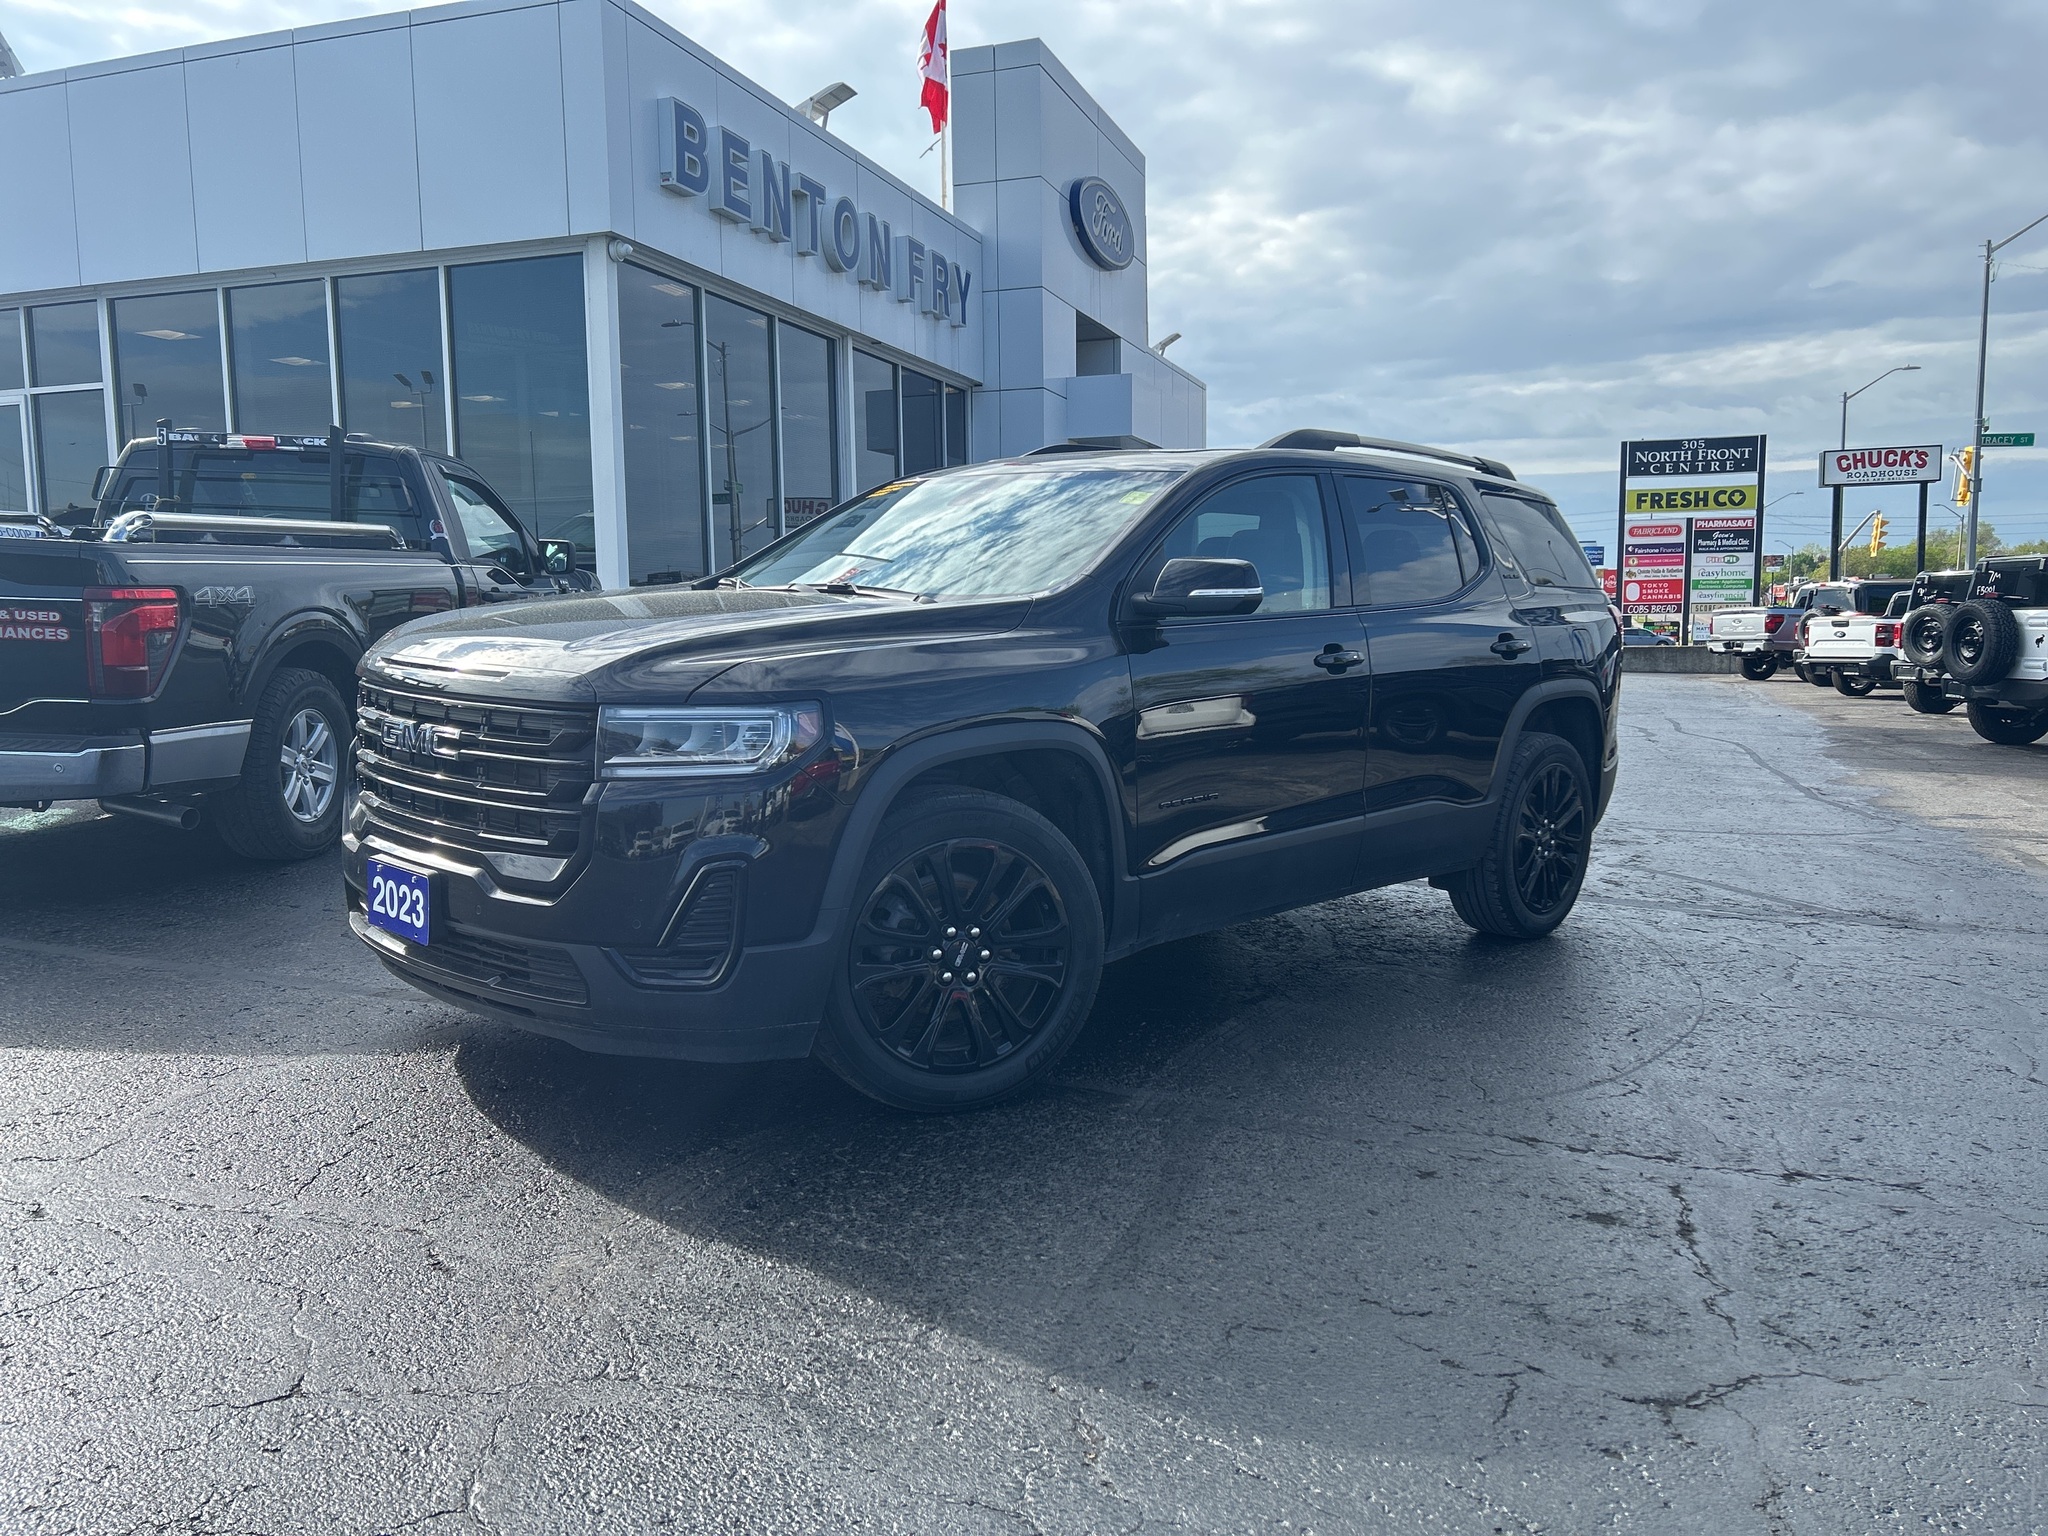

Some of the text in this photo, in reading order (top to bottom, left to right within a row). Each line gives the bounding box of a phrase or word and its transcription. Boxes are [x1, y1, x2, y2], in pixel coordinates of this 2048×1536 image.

[658, 97, 973, 328] BENTON FRY
[1092, 191, 1124, 255] Ford
[1681, 440, 1706, 450] 305
[1981, 436, 2016, 445] TRACEY
[1635, 447, 1753, 464] NORTH FRONT
[1836, 449, 1930, 473] CHUCK'S
[1649, 460, 1735, 474] CENTRE
[1846, 469, 1918, 479] ROADHOUSE
[1636, 490, 1710, 510] FRESH
[1696, 519, 1753, 528] PHARMASAVE
[1632, 526, 1679, 536] FABRICLAND
[1697, 539, 1717, 547] Pharmacy
[1722, 538, 1738, 546] Medical
[1738, 538, 1750, 546] Clinic
[1660, 545, 1683, 553] Financial
[1700, 568, 1747, 579] easyhome
[1699, 591, 1747, 600] easyfinancial
[1627, 604, 1678, 614] COBS BREAD
[15, 611, 60, 621] USED
[381, 717, 461, 760] GMC
[372, 875, 425, 929] 2023
